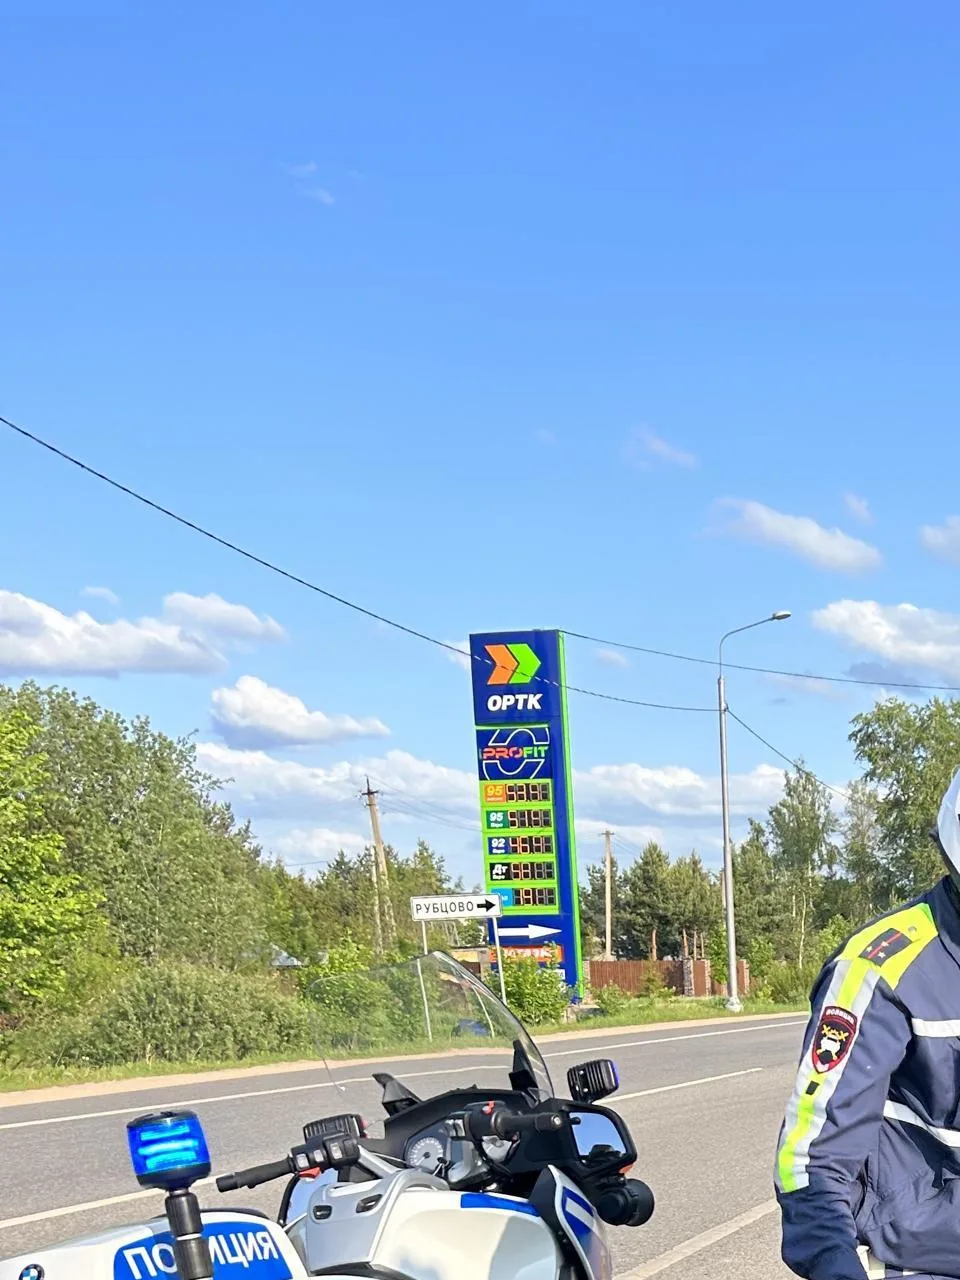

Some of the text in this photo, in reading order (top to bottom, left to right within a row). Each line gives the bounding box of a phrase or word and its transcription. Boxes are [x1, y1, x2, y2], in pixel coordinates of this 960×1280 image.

[487, 693, 544, 711] ОРТК
[483, 746, 548, 759] PROFIT
[487, 785, 503, 796] 95
[489, 812, 504, 821] 95
[491, 838, 506, 848] 92
[415, 901, 474, 914] РУБЦОВО
[124, 1231, 279, 1280] ПОИЦИЯ
